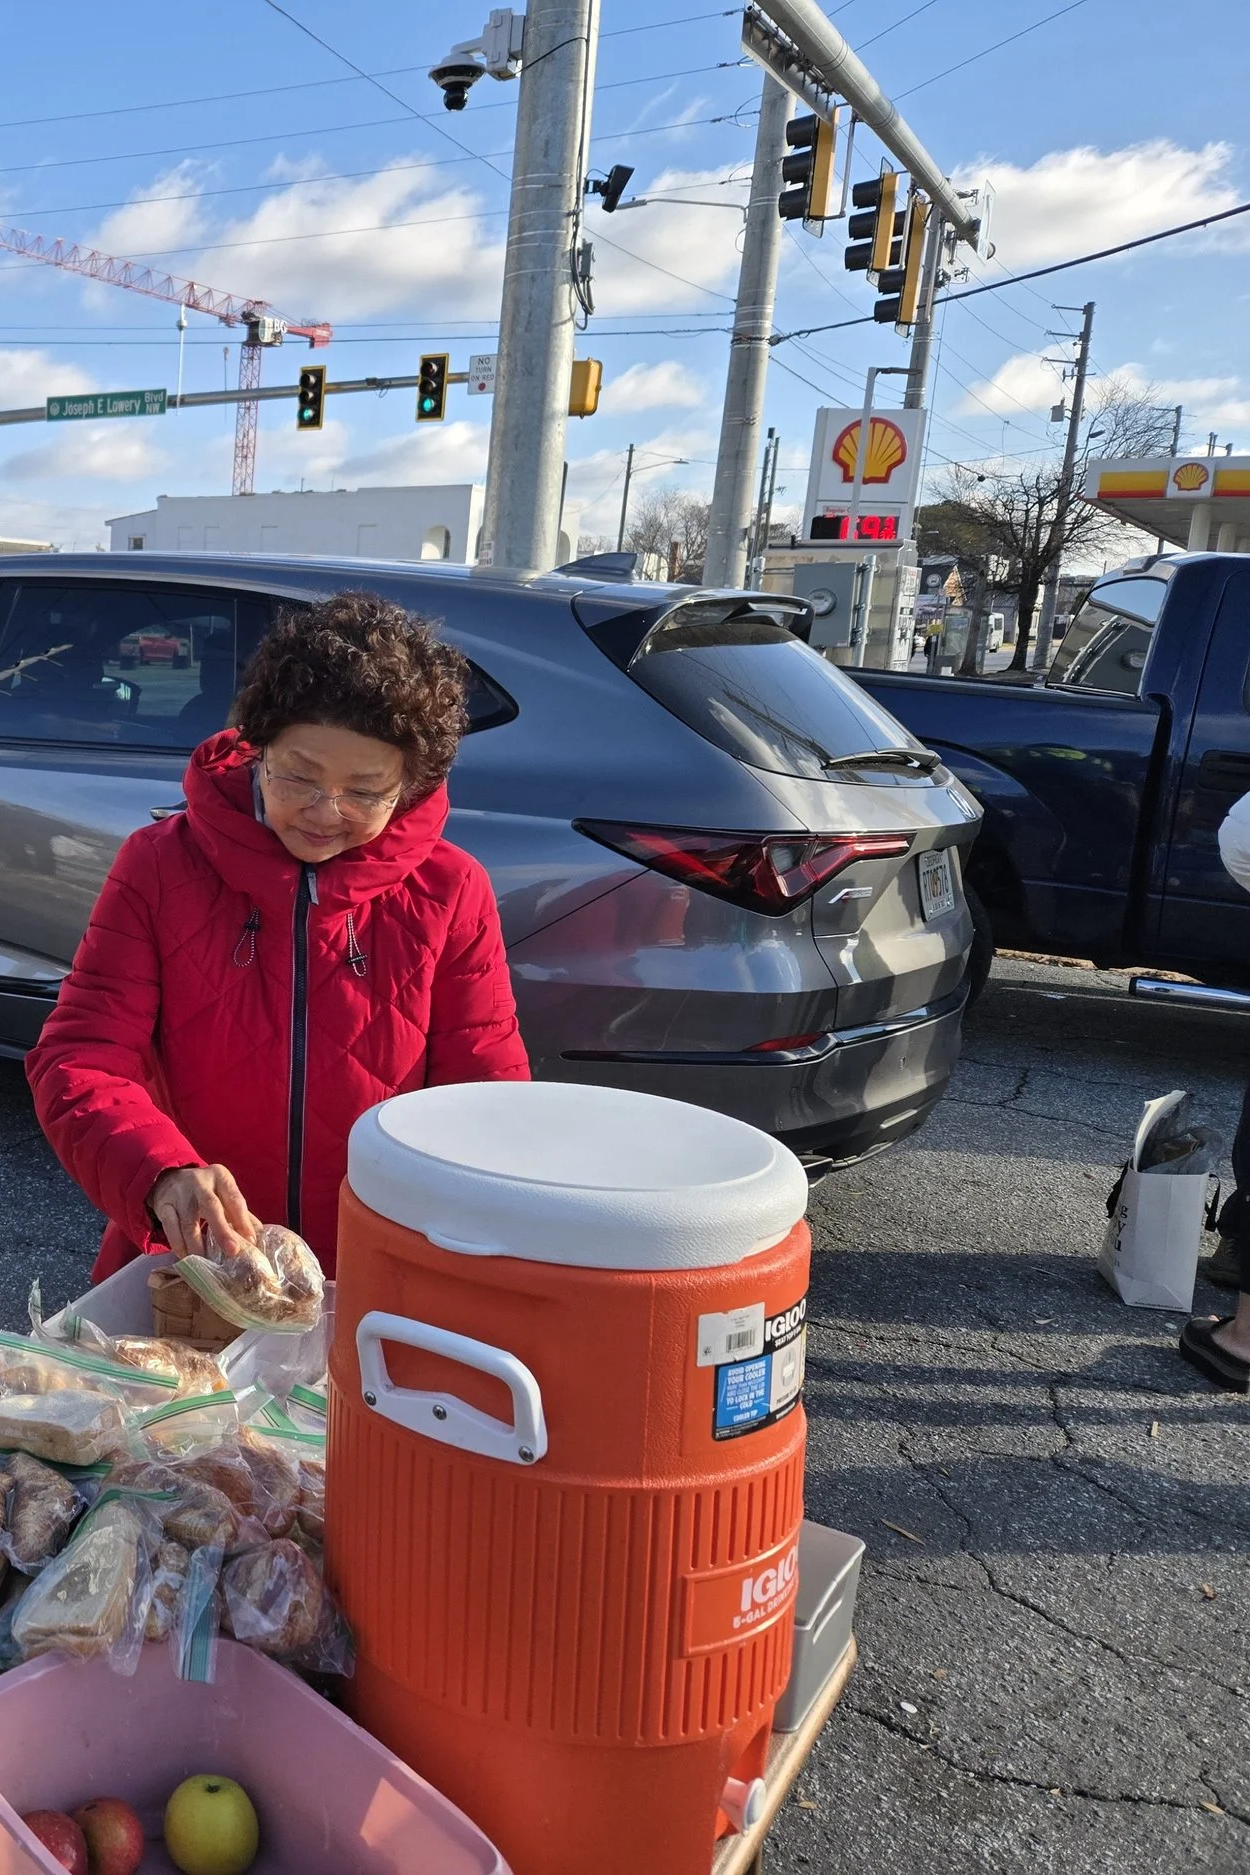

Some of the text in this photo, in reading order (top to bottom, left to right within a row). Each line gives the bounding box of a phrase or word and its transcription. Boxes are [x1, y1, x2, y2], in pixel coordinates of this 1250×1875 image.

[478, 357, 490, 365] NO
[63, 392, 164, 418] Joseph E Lowery Blvd
[146, 404, 161, 414] NW
[765, 1299, 806, 1342] IGLOO
[728, 1368, 766, 1385] YOUR COOLER
[726, 1397, 734, 1406] TO
[735, 1394, 748, 1404] LOCK
[756, 1389, 765, 1398] THE
[740, 1400, 753, 1410] COLD
[741, 1546, 798, 1612] IGLO
